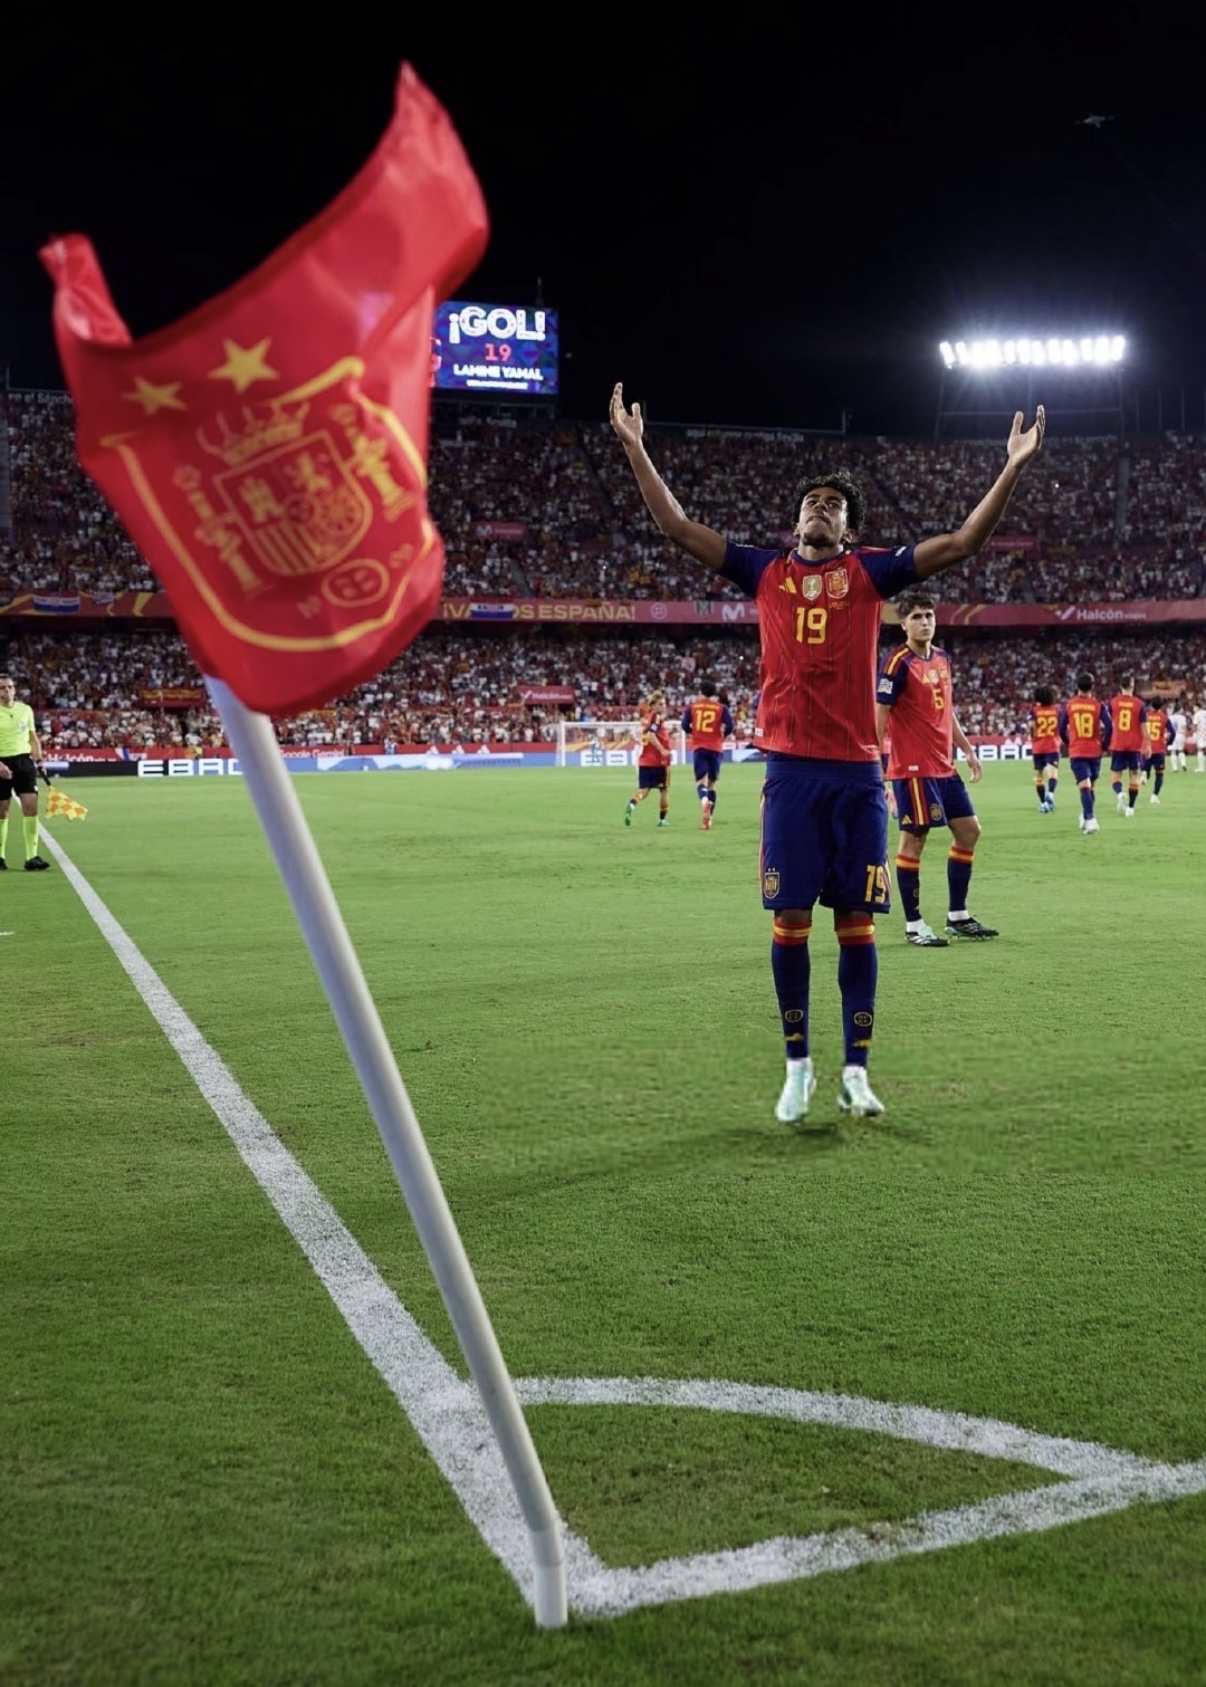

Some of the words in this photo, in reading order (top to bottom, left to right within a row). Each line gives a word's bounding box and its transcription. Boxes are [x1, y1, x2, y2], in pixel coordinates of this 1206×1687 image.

[449, 305, 546, 344] ¡GOL!
[485, 343, 512, 361] 19
[502, 366, 544, 381] YAMAL
[538, 602, 636, 619] ESPAÑA!
[1077, 608, 1123, 620] Halcón
[796, 607, 828, 644] 19
[696, 710, 716, 732] 12
[1037, 717, 1058, 737] 22
[1073, 713, 1093, 738] 18
[1119, 710, 1131, 731] 8
